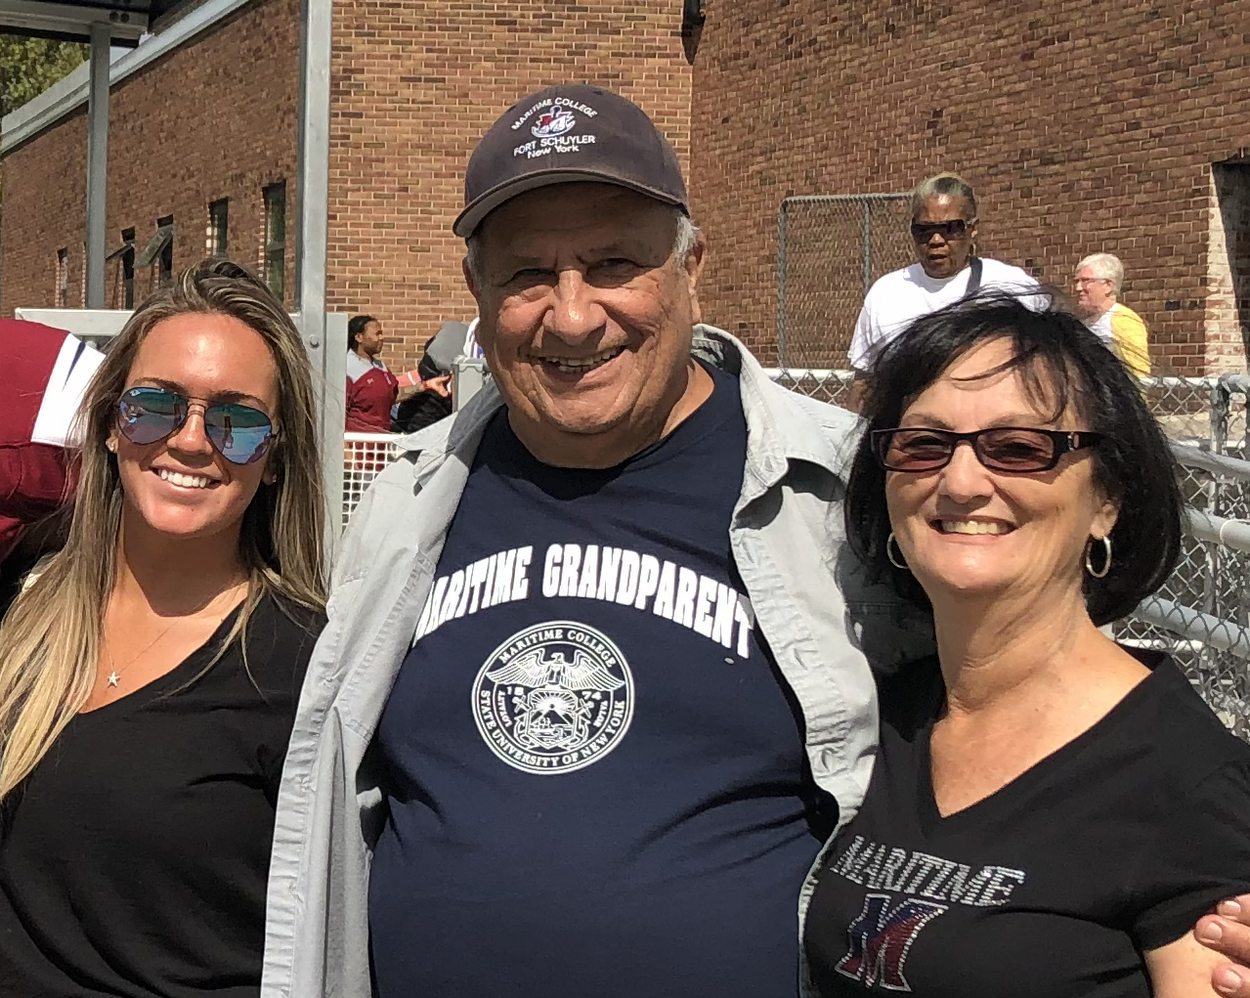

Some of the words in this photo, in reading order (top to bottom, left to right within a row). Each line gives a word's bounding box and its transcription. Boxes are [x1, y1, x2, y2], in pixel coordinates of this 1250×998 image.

[511, 99, 552, 130] MARITIME
[554, 97, 598, 118] COLLEGE
[513, 141, 537, 157] FORT
[540, 135, 596, 147] SCHUYLER
[527, 147, 551, 159] New
[554, 145, 579, 153] York
[541, 543, 754, 660] GRANDPARENT
[498, 629, 564, 664] MARITIME
[567, 630, 617, 668] COLLEGE
[581, 691, 602, 701] 74
[480, 689, 497, 730] STATE
[492, 728, 560, 767] UNIVERSITY
[561, 752, 579, 765] OF
[580, 733, 608, 758] NEW
[604, 700, 625, 734] YORK
[830, 835, 1026, 907] MARITIME
